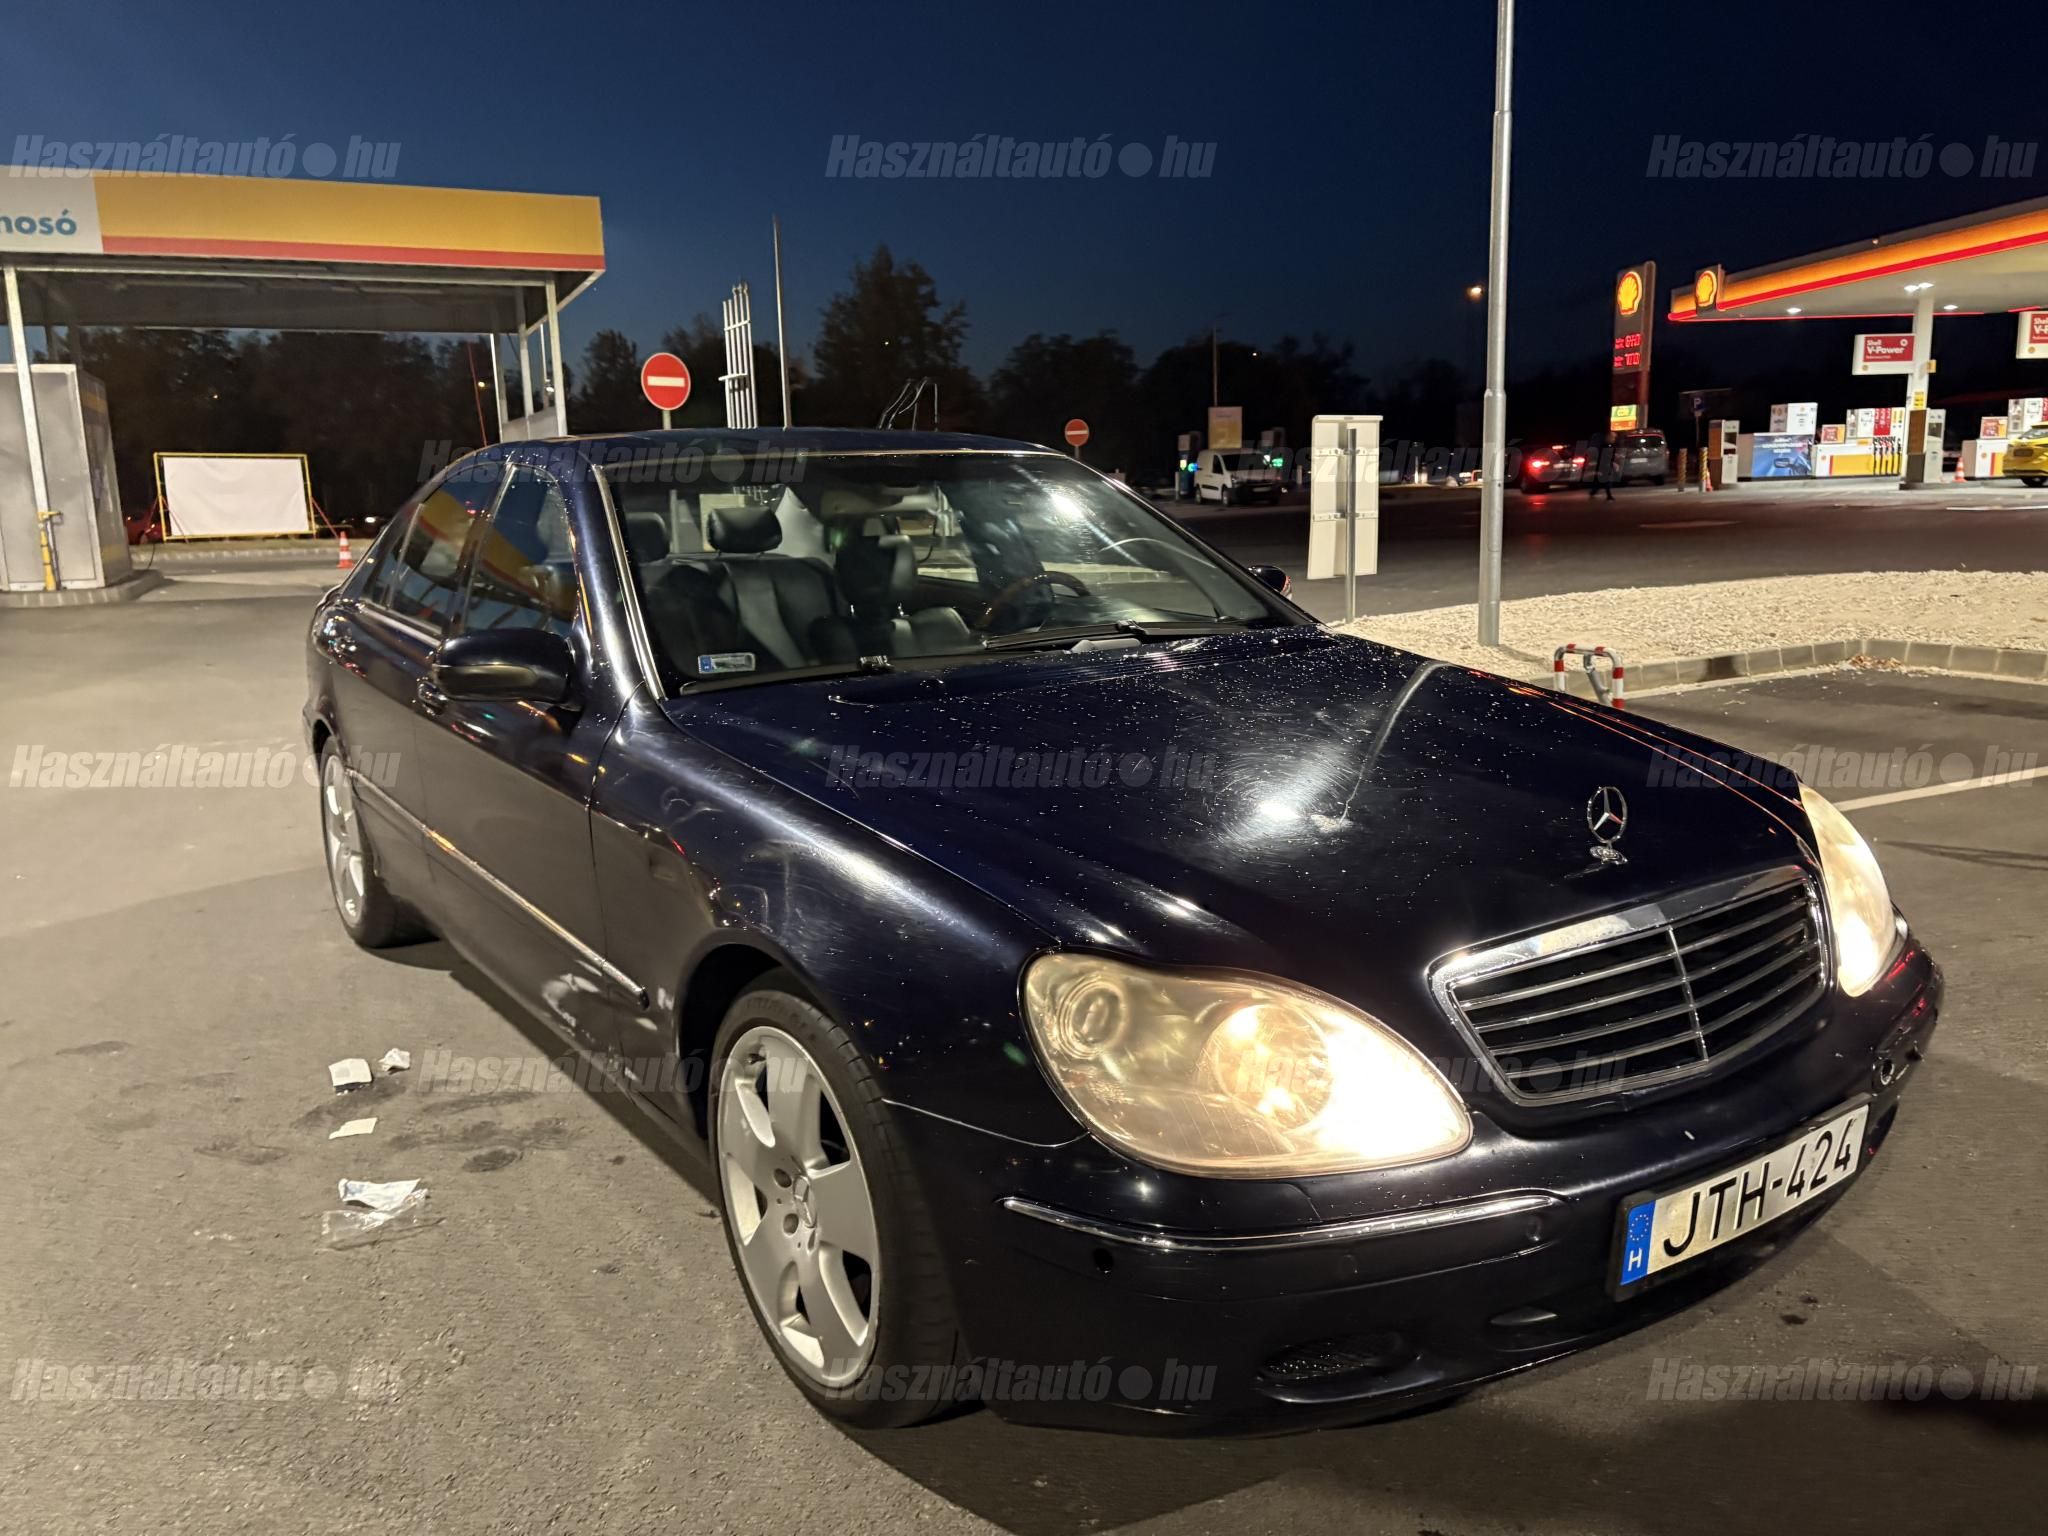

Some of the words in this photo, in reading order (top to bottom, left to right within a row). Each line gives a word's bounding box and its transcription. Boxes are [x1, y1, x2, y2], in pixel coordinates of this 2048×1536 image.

[1866, 345, 1905, 355] V-Power
[1663, 1117, 1854, 1257] JTH-424
[1628, 1249, 1643, 1272] H
